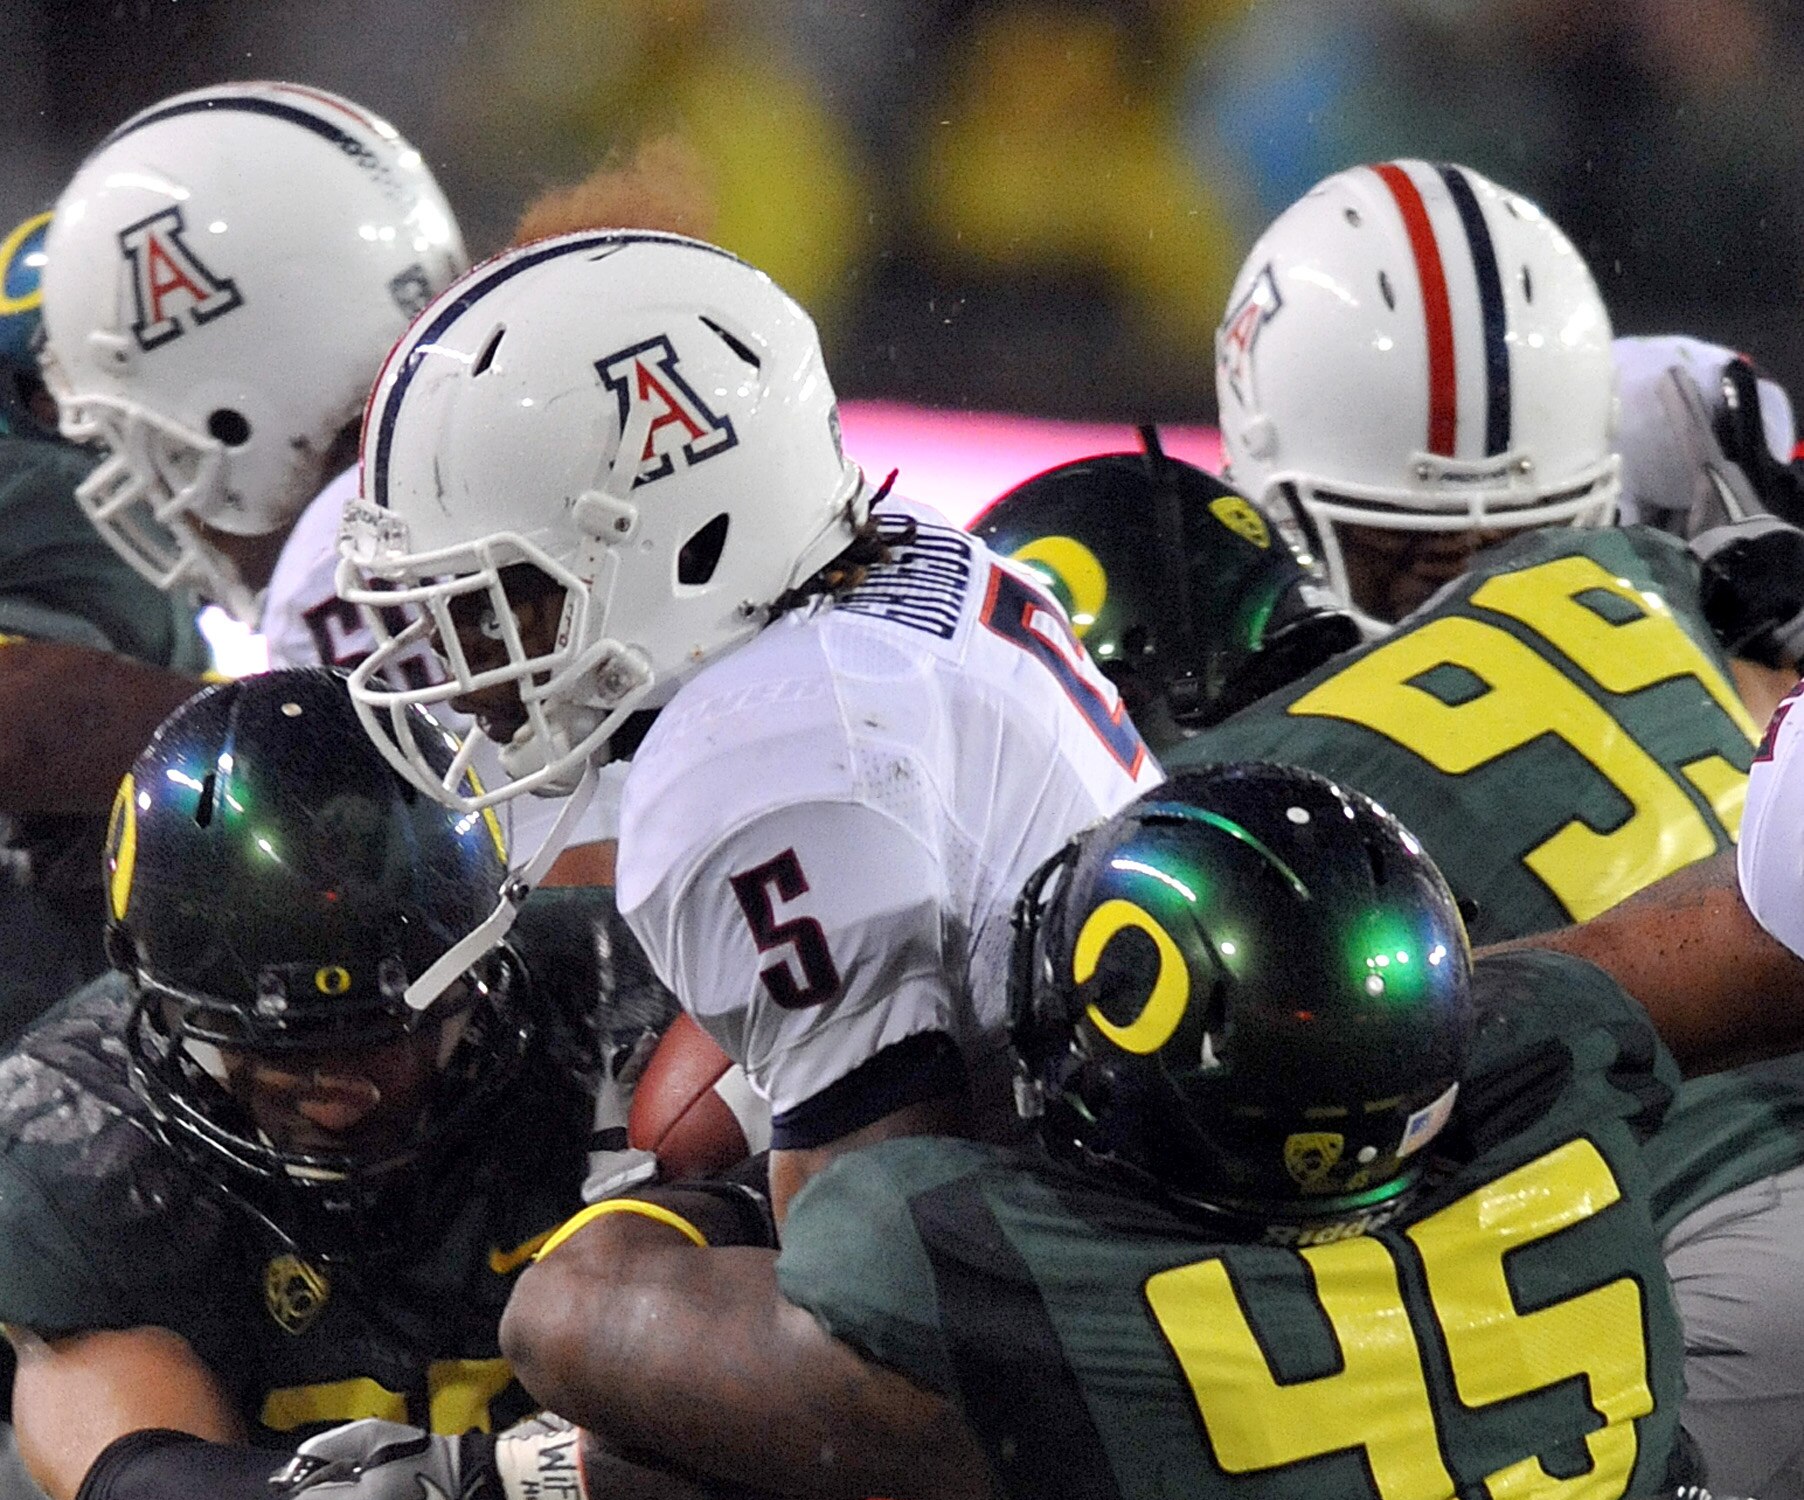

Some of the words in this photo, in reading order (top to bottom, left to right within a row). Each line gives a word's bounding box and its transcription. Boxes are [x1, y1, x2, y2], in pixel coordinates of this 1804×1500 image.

[118, 205, 243, 351] A
[595, 334, 740, 488] A
[729, 847, 841, 1010] 5
